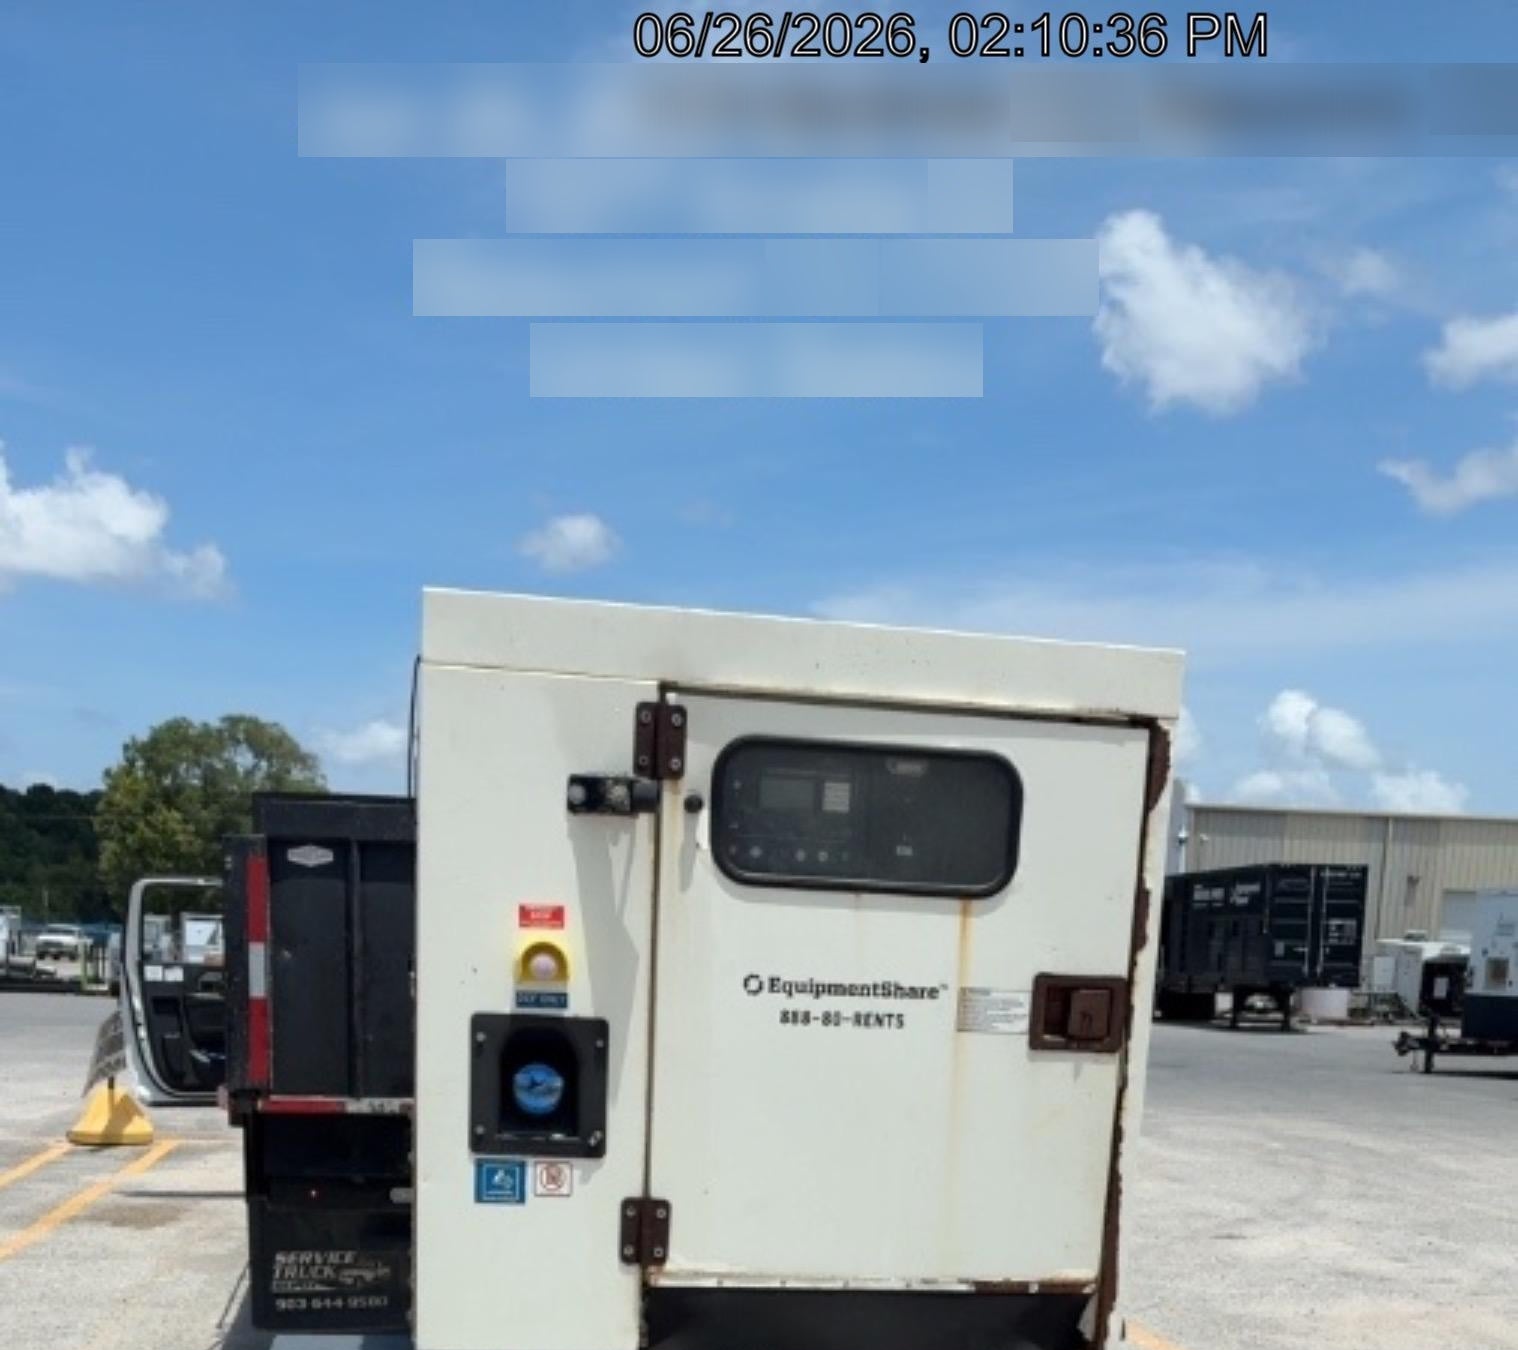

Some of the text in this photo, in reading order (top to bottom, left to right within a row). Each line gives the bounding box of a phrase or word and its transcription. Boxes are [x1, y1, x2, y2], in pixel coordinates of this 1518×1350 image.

[779, 1008, 905, 1030] 888-80-RENTS
[274, 1250, 358, 1264] SERVICE
[272, 1263, 337, 1280] TRUCK
